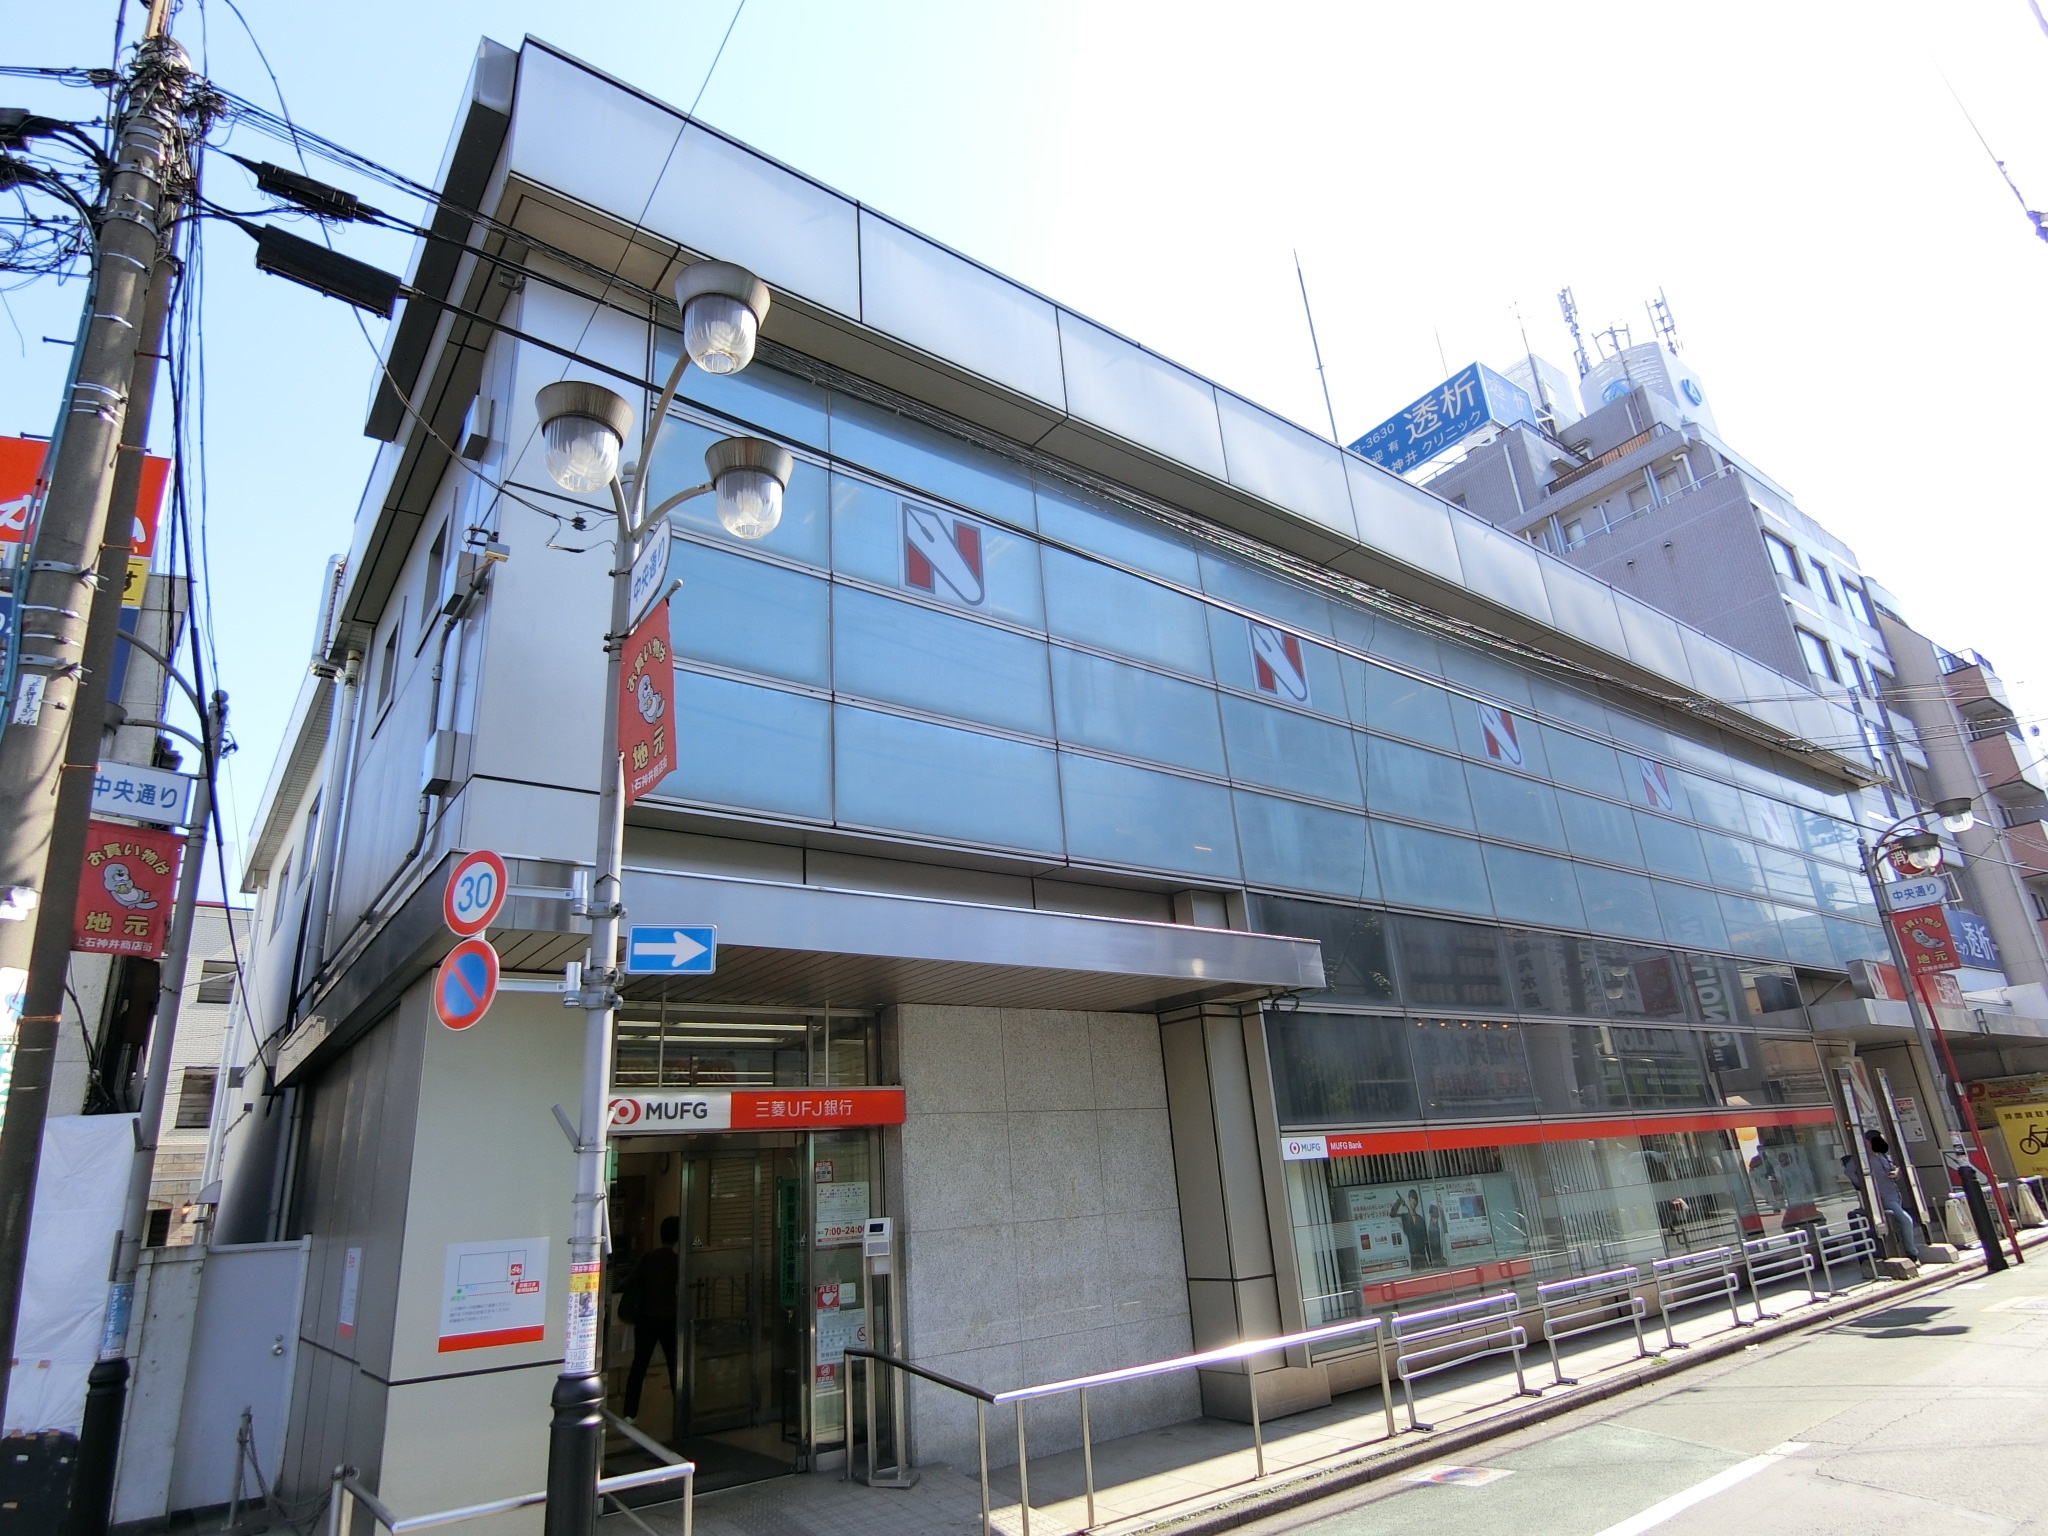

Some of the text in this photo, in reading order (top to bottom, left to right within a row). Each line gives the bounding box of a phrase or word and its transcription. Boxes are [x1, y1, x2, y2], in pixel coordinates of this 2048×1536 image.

[1403, 370, 1476, 445] 透析
[1422, 410, 1481, 455] クリニック
[633, 536, 665, 603] 中央通り
[626, 636, 667, 692] お買い物は
[632, 724, 665, 773] 地元
[94, 775, 179, 809] 中央通り
[87, 842, 171, 876] お買い物は
[458, 872, 493, 912] 30
[1892, 882, 1937, 901] 中央通り
[85, 911, 150, 936] 地元
[1900, 917, 1942, 935] お買い物は
[76, 936, 153, 953] 上石神井商店街
[1961, 920, 1995, 961] 透析
[1916, 950, 1949, 965] 地元
[645, 1101, 708, 1120] MUFG
[755, 1099, 853, 1118] 三菱UFJ銀行
[1301, 1142, 1321, 1152] MUFG
[1330, 1140, 1363, 1150] MUFG Bank
